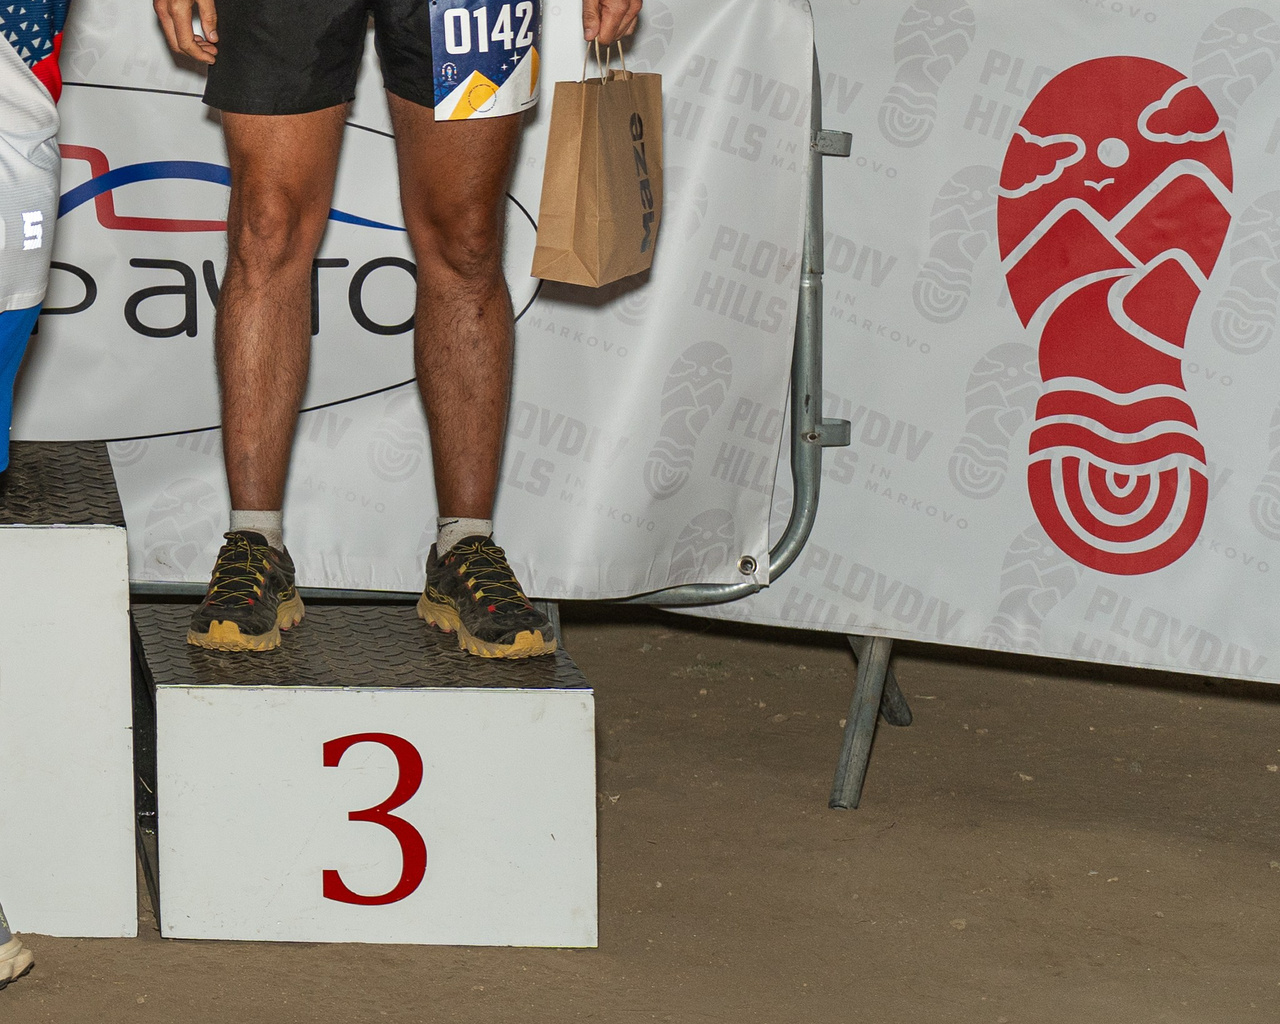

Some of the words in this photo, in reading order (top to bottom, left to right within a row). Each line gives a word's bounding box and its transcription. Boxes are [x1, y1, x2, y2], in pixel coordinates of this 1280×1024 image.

[444, 0, 534, 55] 0142
[693, 270, 788, 334] HILLS
[834, 289, 857, 308] IN
[528, 315, 629, 358] MARKOVO
[829, 305, 932, 355] MARKOVO
[869, 463, 892, 481] IN
[864, 478, 969, 531] MARKOVO
[798, 543, 965, 640] PLOVDIV
[1083, 584, 1269, 675] PLOVDIV
[322, 732, 427, 906] 3
